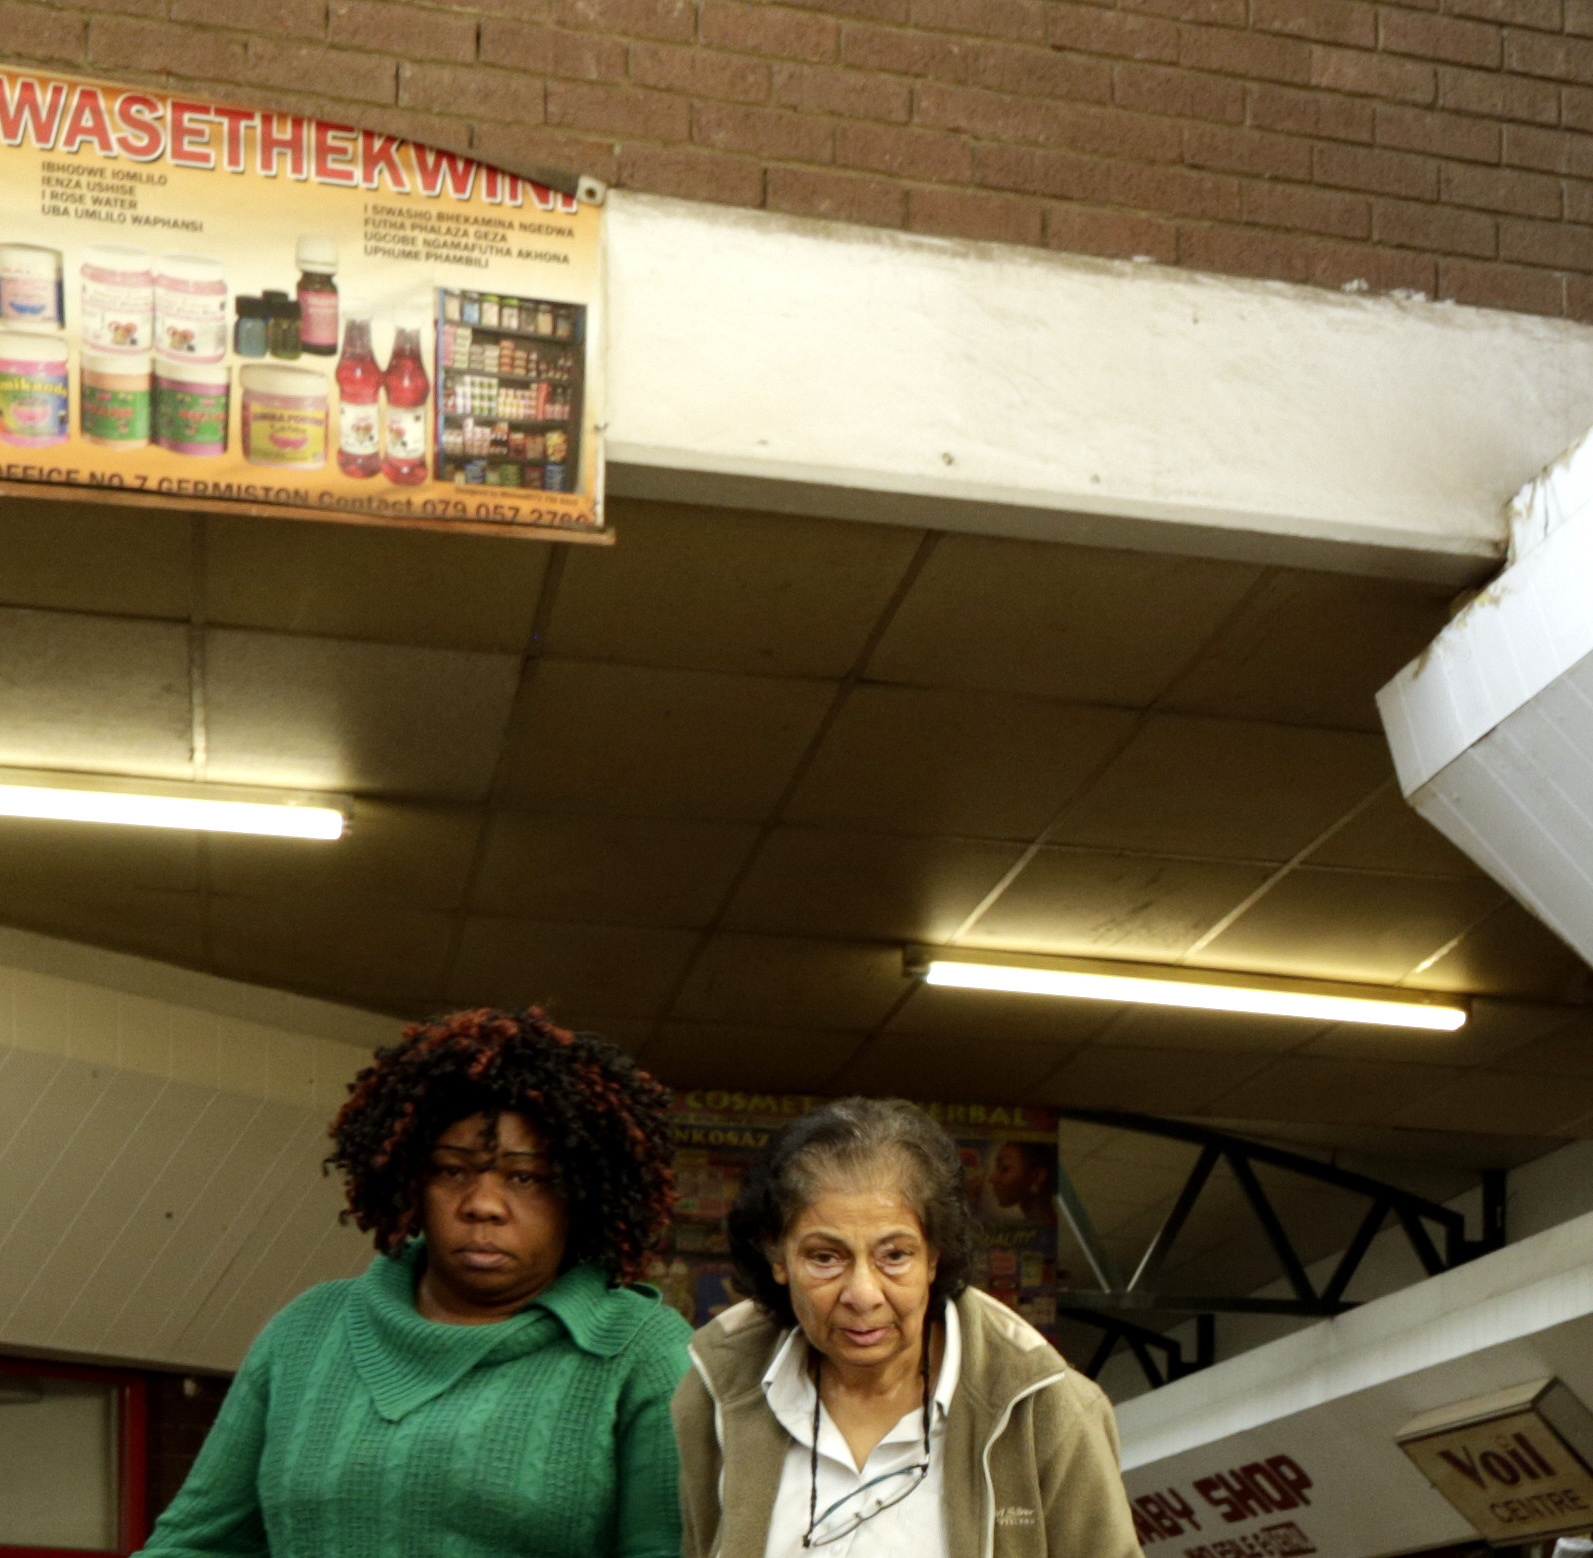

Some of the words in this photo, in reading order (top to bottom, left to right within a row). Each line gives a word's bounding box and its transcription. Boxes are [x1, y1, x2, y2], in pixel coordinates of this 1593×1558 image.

[90, 196, 139, 211] WATER
[1191, 1453, 1313, 1524] SHOP
[1489, 1488, 1591, 1524] CENTRE
